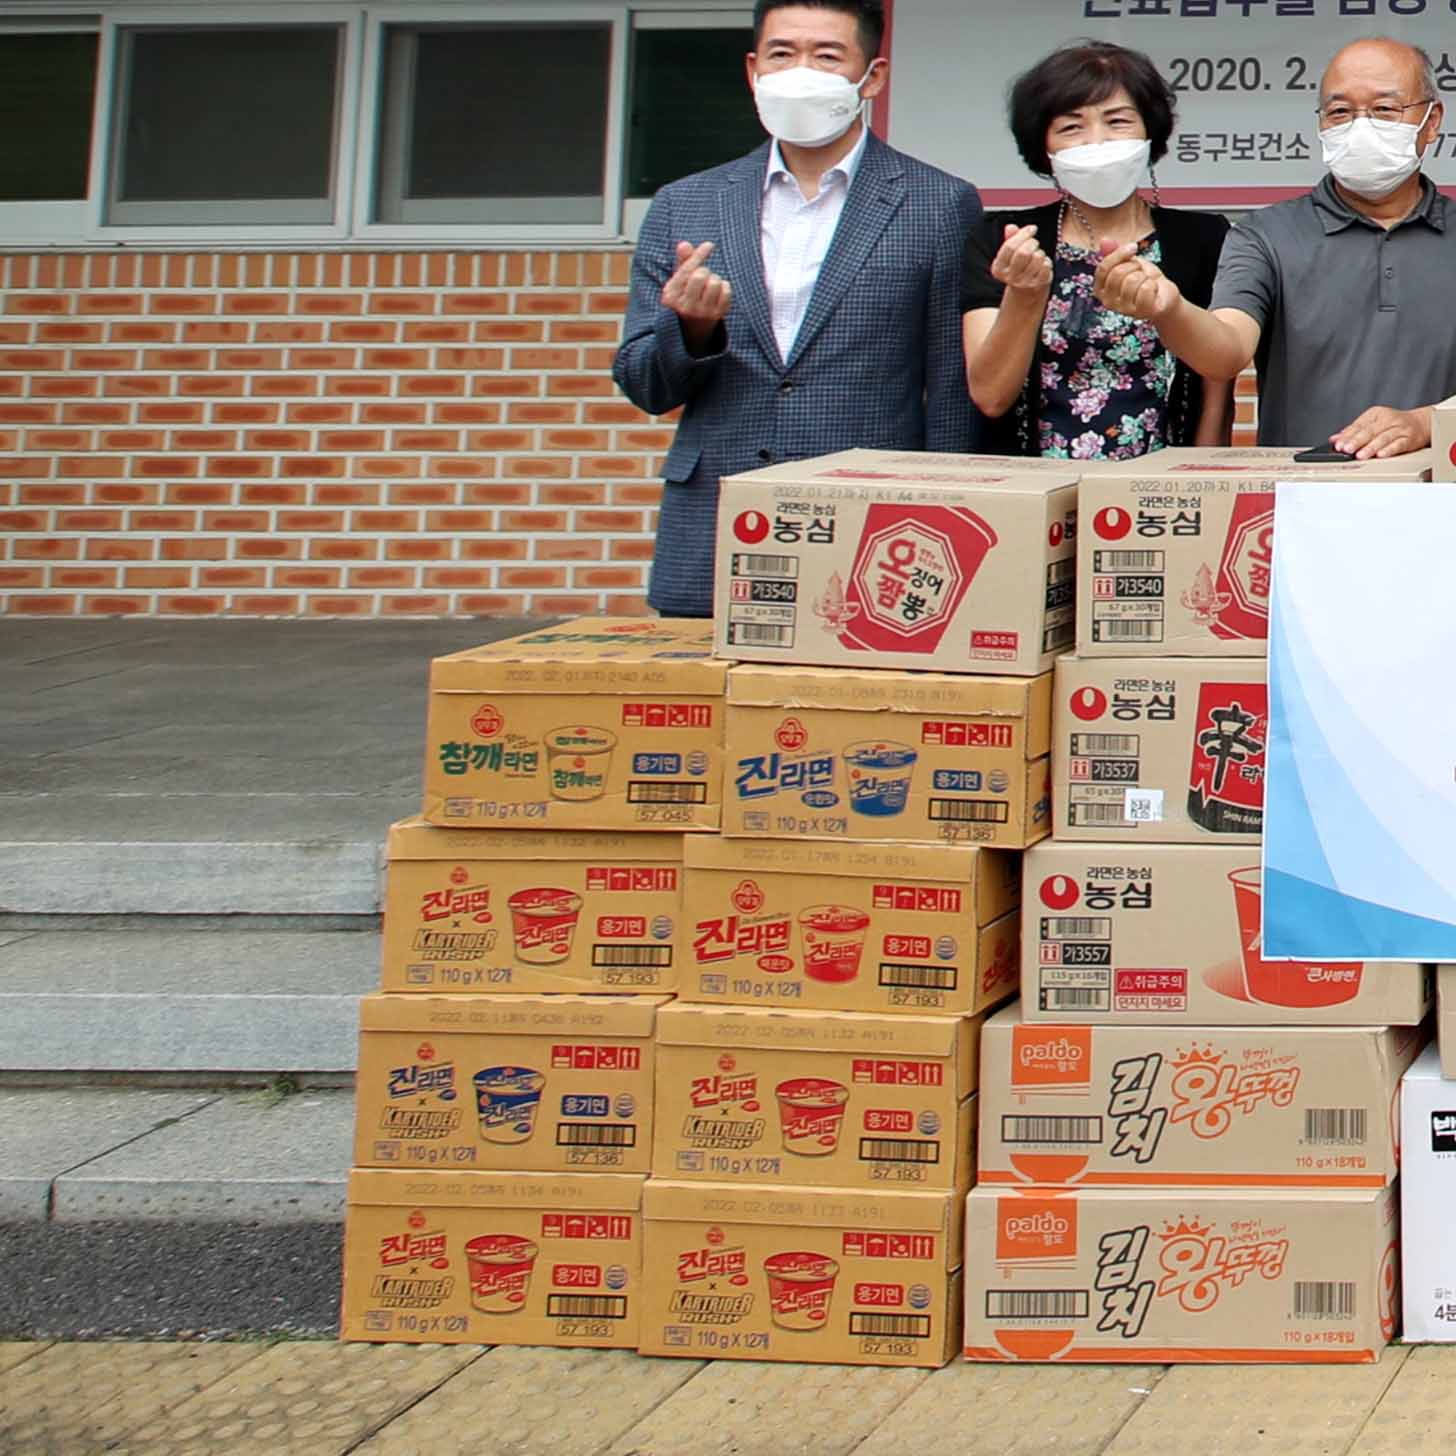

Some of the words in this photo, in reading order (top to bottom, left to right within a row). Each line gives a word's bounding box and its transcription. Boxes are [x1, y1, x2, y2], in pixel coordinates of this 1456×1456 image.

[1169, 57, 1272, 93] 2020.
[1176, 132, 1311, 165] 동구보건소
[773, 516, 836, 544] 농심
[1111, 693, 1177, 721] 농심
[439, 740, 539, 776] 참깨라면
[734, 751, 835, 801] 진라면
[692, 914, 793, 965] 진라면
[1063, 945, 1109, 963] 가3557
[1020, 1038, 1082, 1068] paldo
[1005, 1212, 1069, 1242] paldo
